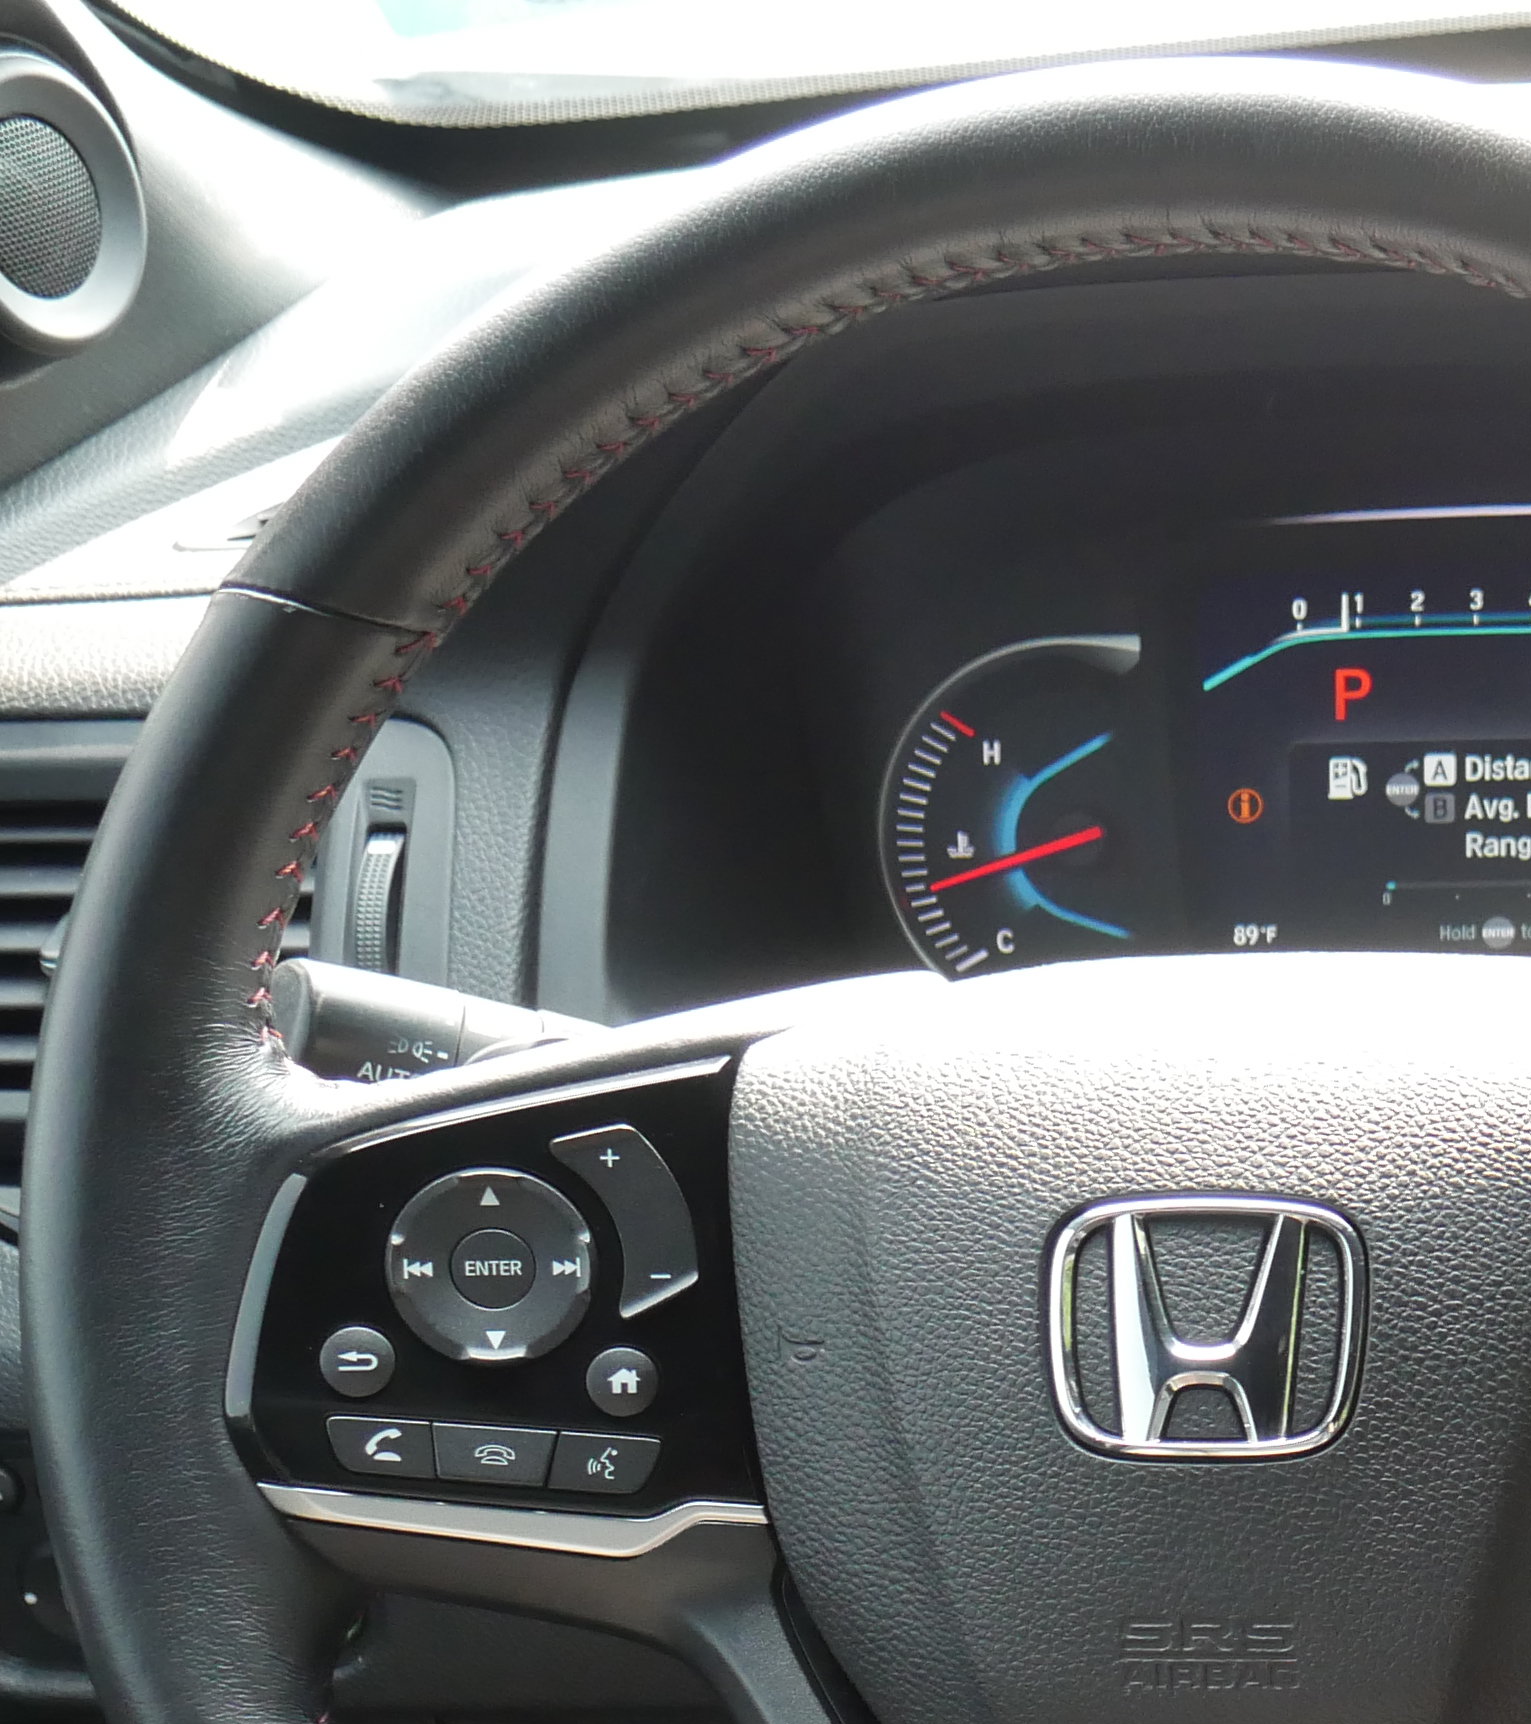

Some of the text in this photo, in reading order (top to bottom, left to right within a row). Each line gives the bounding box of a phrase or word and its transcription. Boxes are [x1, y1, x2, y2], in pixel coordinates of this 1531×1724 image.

[1292, 597, 1307, 620] 0
[1354, 592, 1364, 613] 1
[1410, 590, 1425, 611] 2
[1468, 589, 1483, 610] 3
[1334, 669, 1372, 719] P
[983, 740, 1000, 765] H
[1464, 793, 1519, 822] Avg.
[997, 930, 1014, 954] C
[1233, 925, 1277, 945] 89°F
[1439, 923, 1475, 941] Hold
[357, 1061, 421, 1082] AUT
[465, 1260, 522, 1276] ENTER
[1121, 1621, 1295, 1653] SRS
